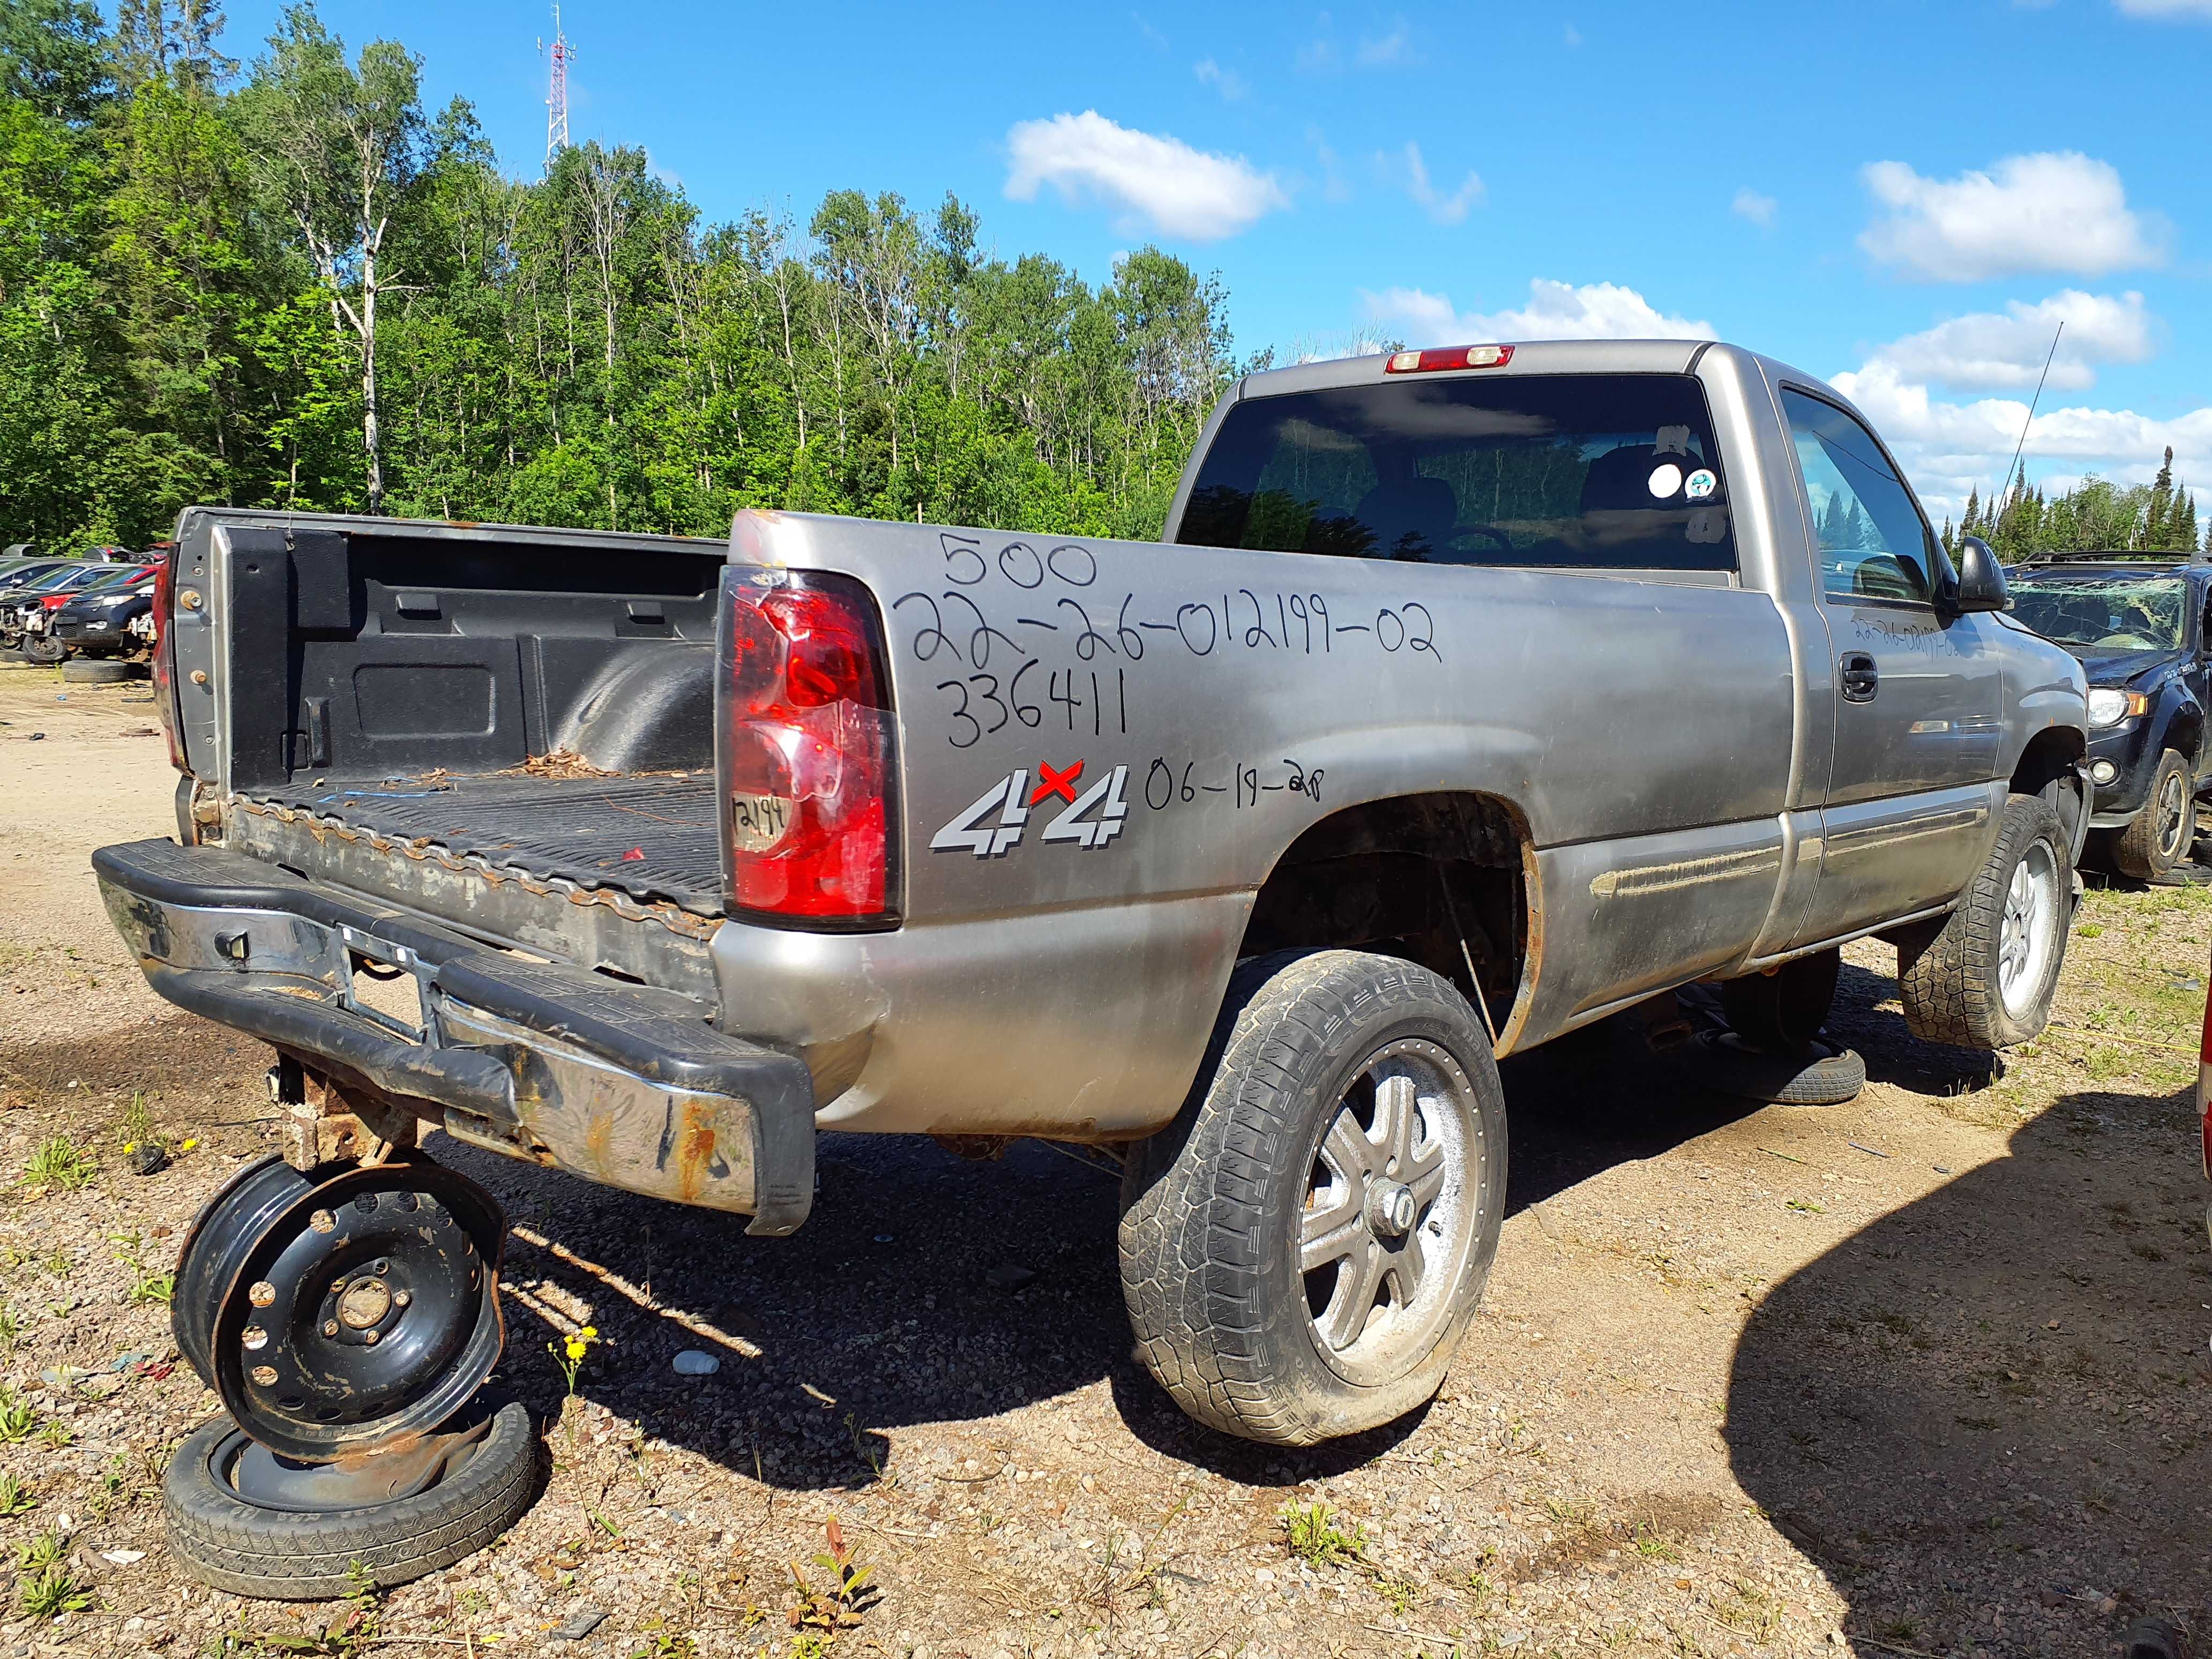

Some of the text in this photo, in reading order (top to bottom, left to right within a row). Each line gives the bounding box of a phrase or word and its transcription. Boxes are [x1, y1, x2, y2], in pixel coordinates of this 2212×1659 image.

[940, 533, 1097, 588] 500
[893, 589, 1443, 670] 22-26-012199-02
[937, 659, 1126, 749] 336411
